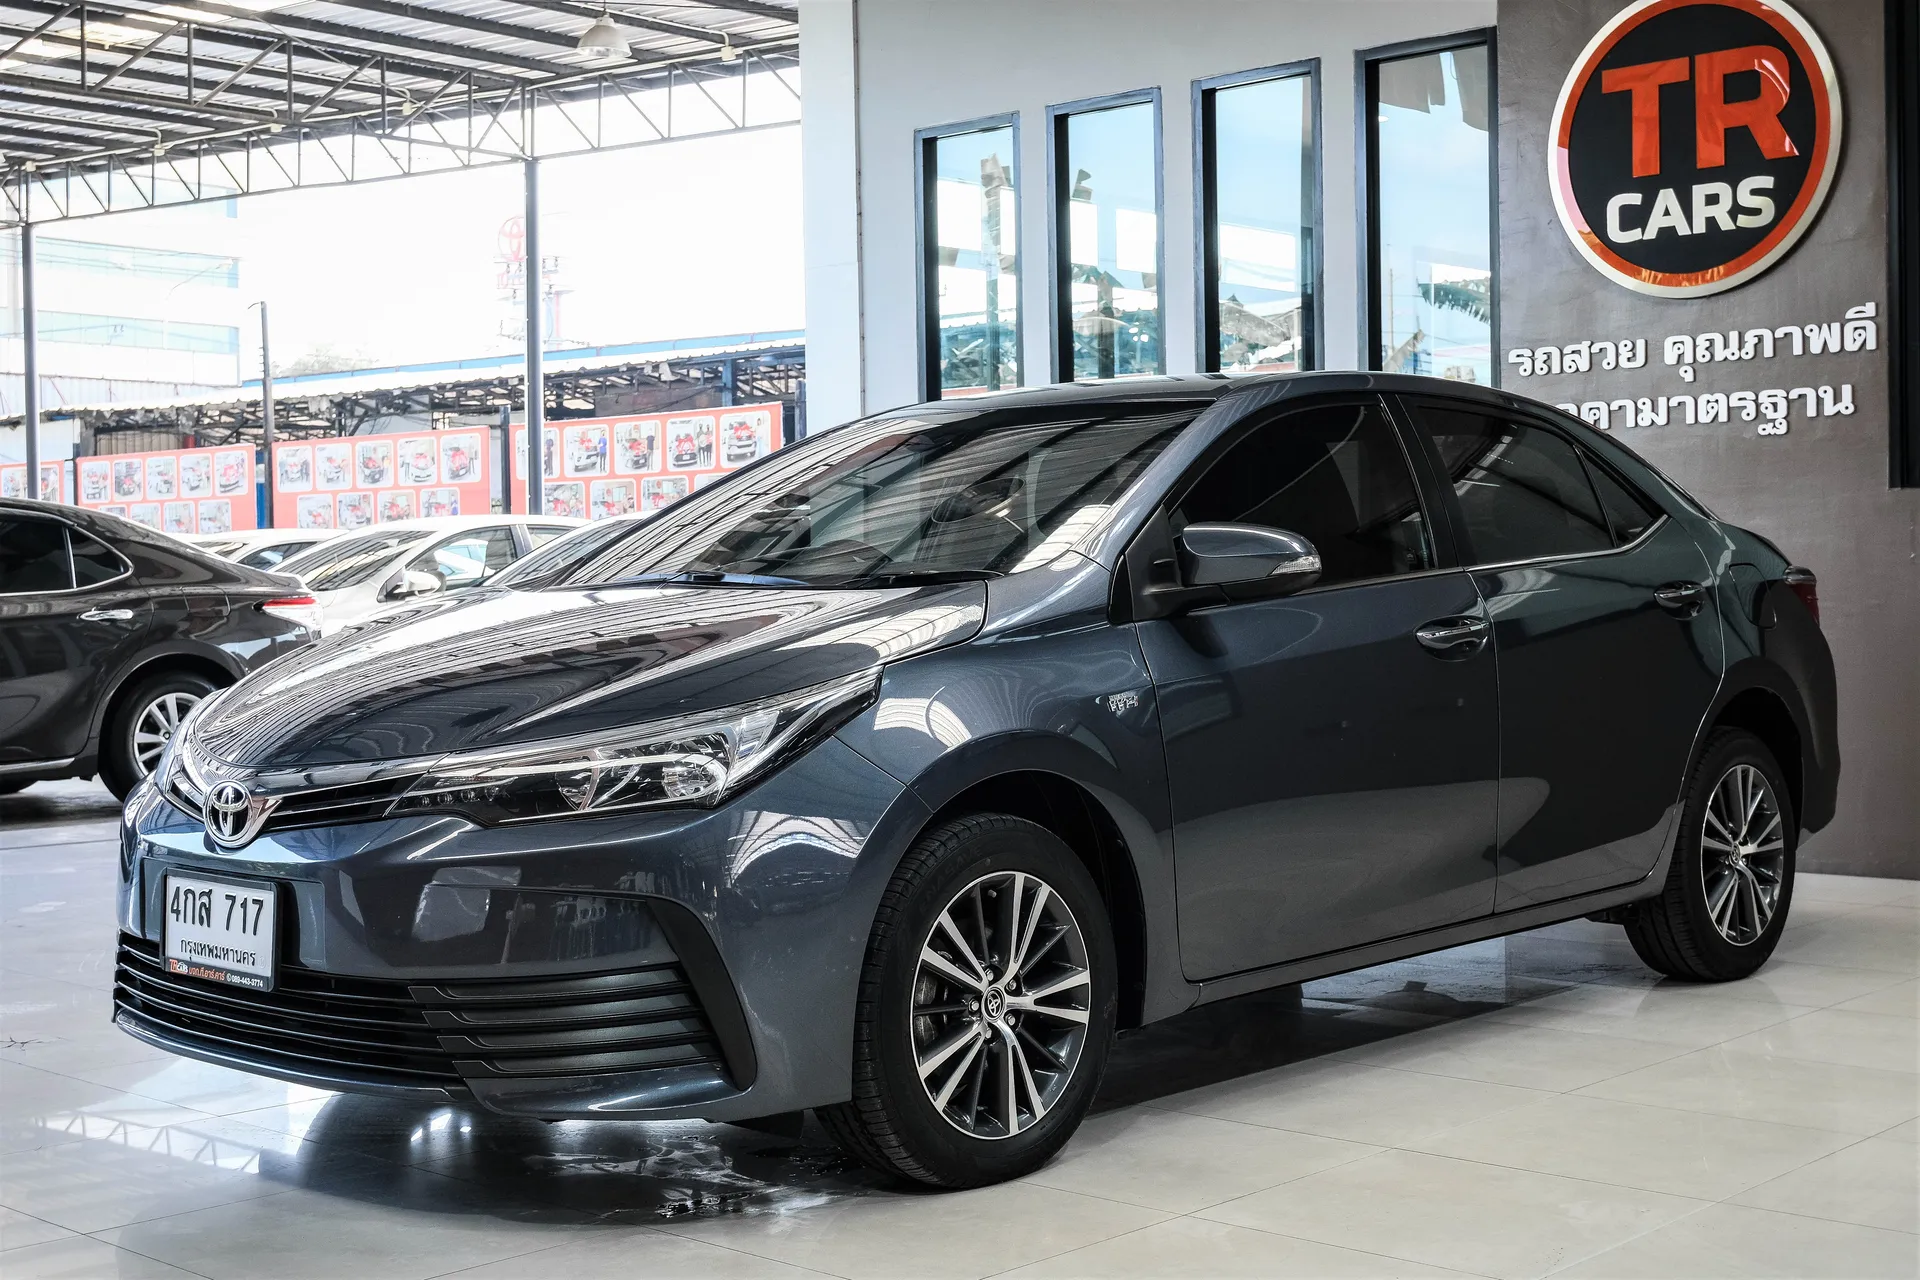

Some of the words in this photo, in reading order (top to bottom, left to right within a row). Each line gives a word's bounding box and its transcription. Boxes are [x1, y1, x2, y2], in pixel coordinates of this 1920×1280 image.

[1601, 44, 1800, 178] TR
[1606, 175, 1776, 244] CARS
[1508, 337, 1647, 377] รถสวย
[1663, 301, 1878, 383] คุณภาพดี
[1554, 383, 1856, 436] คามาตรฐาน
[170, 884, 213, 928] 4กส
[224, 892, 264, 936] 717
[180, 938, 256, 966] กรุงเทพมหานคร
